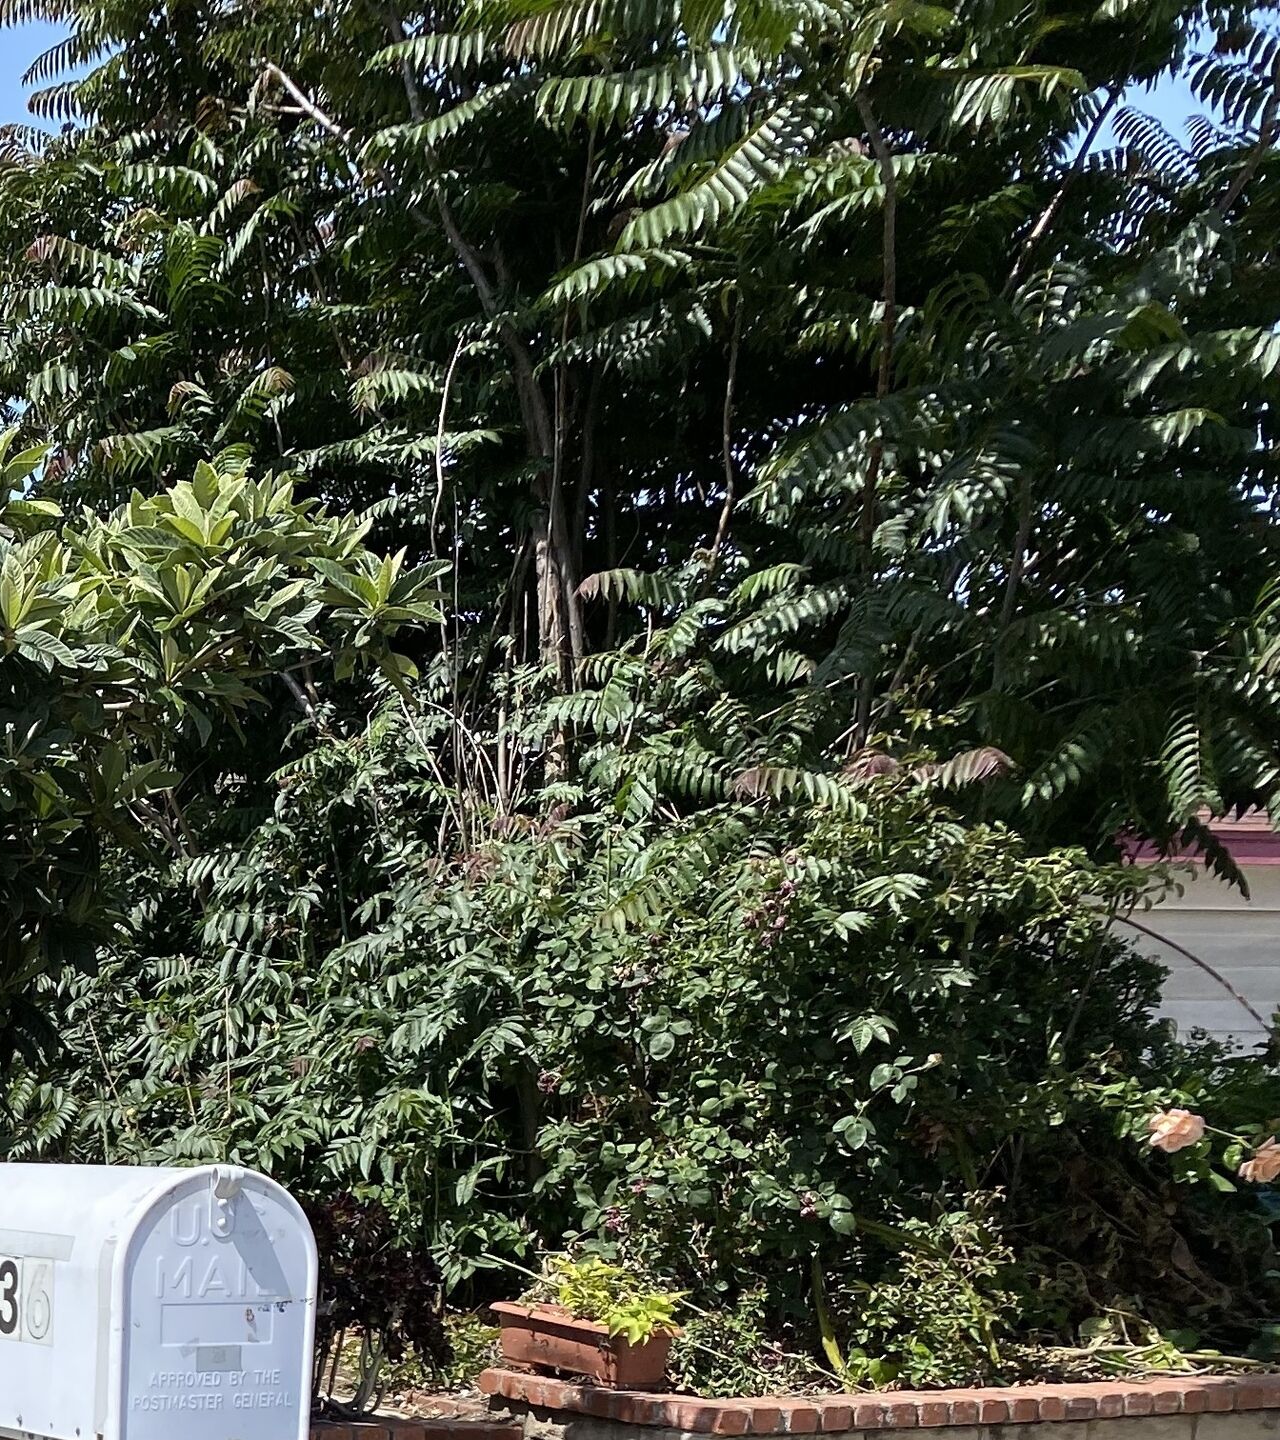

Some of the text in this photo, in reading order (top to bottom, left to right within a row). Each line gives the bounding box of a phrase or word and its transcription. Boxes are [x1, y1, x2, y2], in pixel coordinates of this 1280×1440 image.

[149, 1369, 281, 1389] APPROVED BY THE
[132, 1391, 294, 1412] POSTMASTER GENERAL
